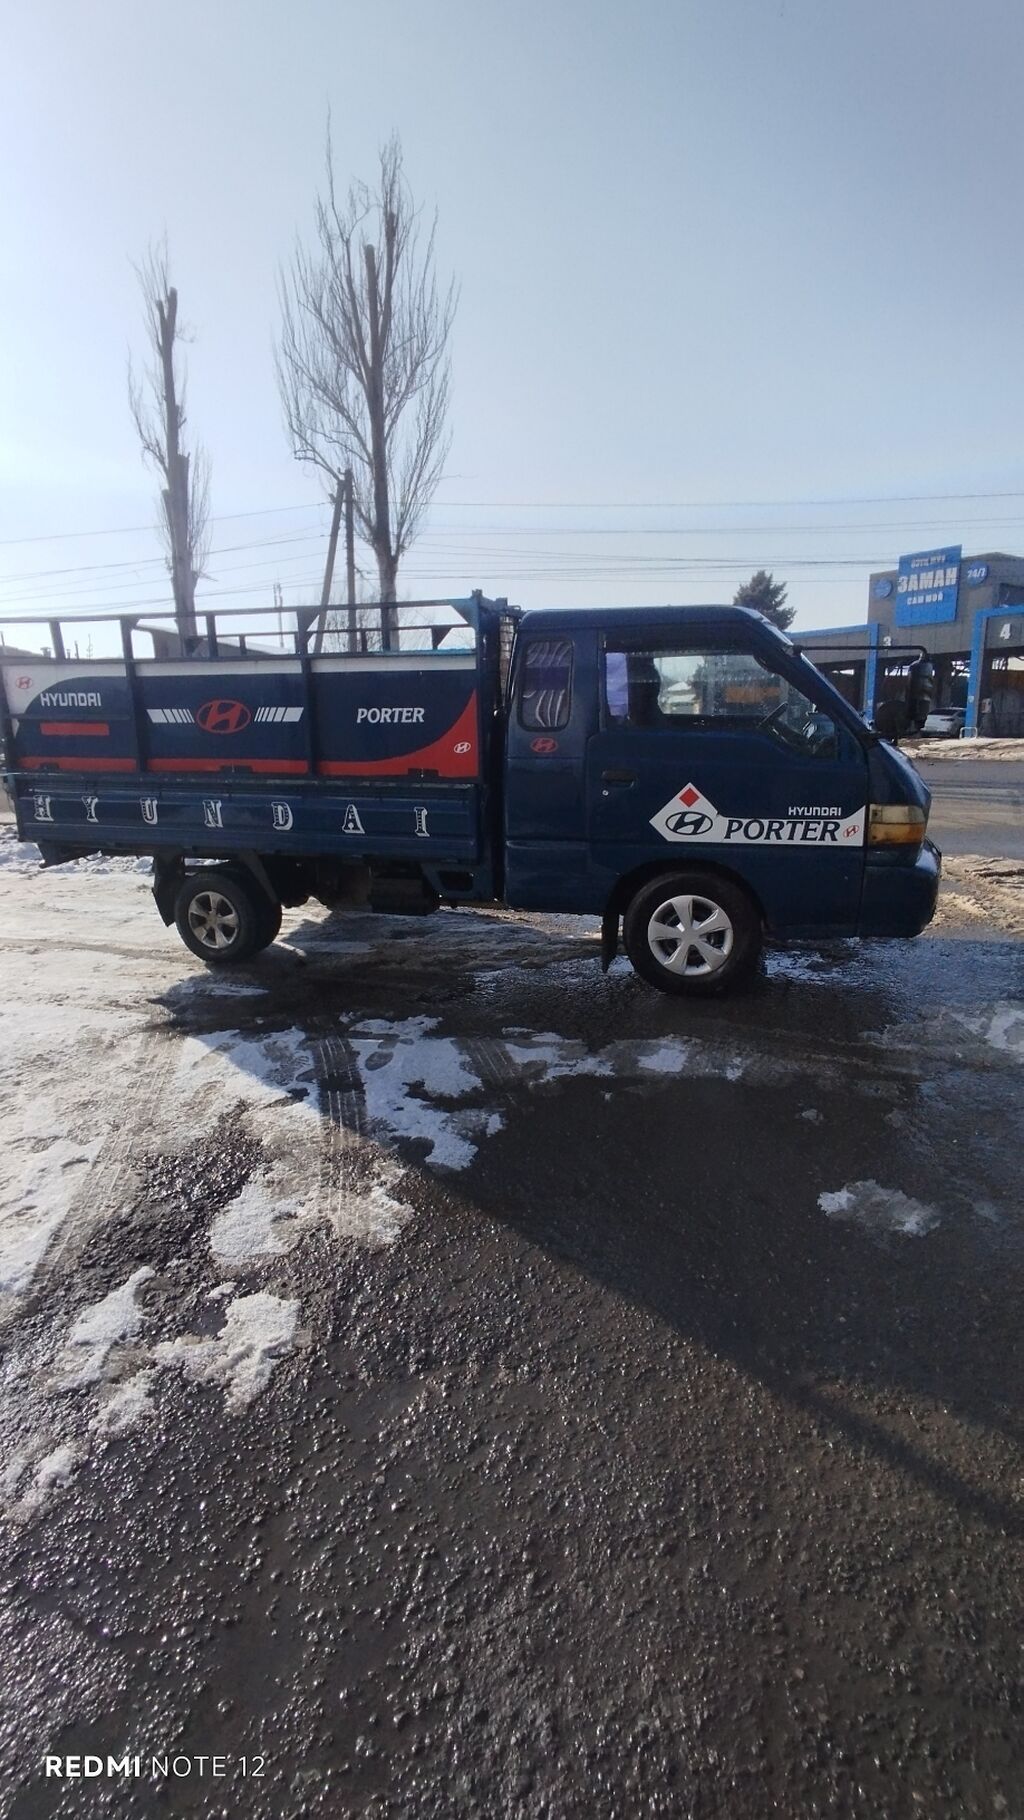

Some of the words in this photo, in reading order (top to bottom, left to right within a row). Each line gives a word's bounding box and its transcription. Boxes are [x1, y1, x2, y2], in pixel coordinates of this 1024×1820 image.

[897, 567, 957, 592] ЗАМАН
[967, 567, 986, 577] 24/7
[1000, 623, 1011, 640] 4
[40, 692, 102, 707] HYUNDAI
[356, 707, 425, 724] PORTER
[788, 806, 842, 817] HYUNDAI
[724, 819, 841, 842] PORTER
